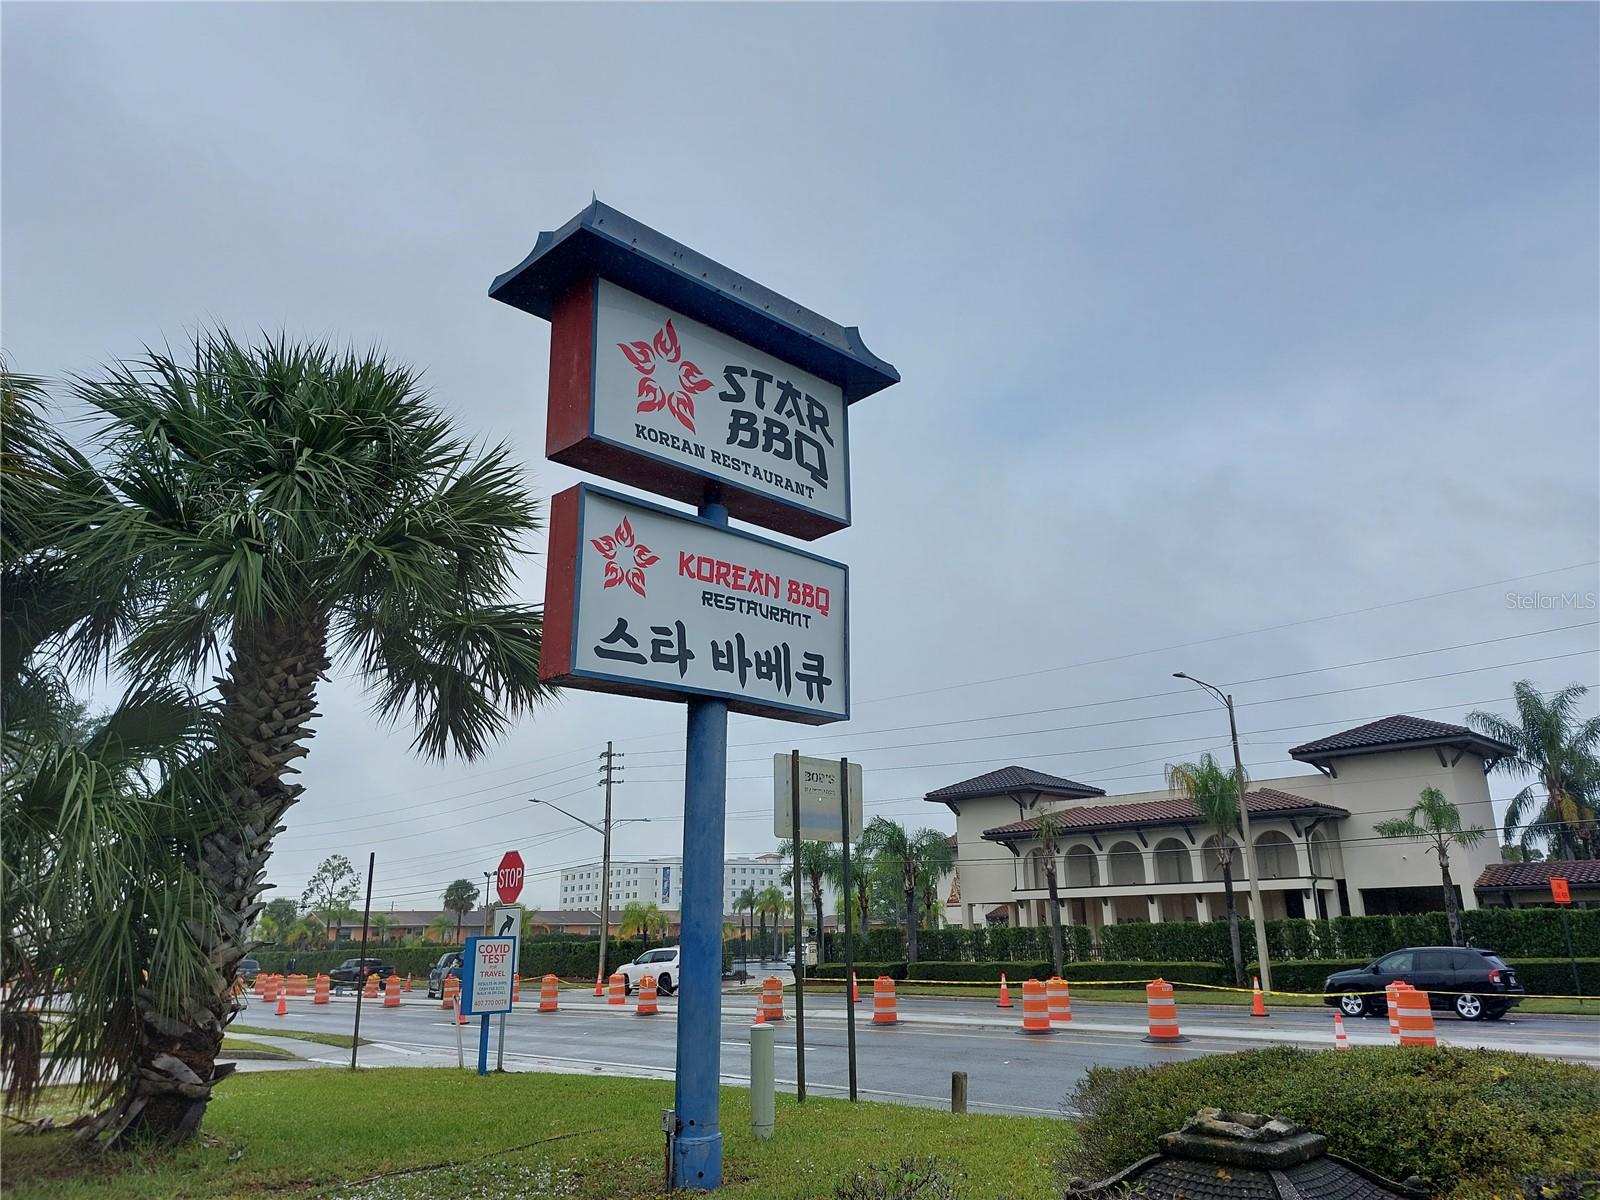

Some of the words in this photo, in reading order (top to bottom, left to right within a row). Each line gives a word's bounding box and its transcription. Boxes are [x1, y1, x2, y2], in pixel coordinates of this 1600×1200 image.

[718, 364, 834, 448] STAR
[634, 423, 706, 459] KOREAN
[710, 448, 815, 499] RESTAURANT
[726, 408, 829, 490] BBQ
[678, 550, 780, 599] KOREAN
[787, 578, 830, 617] BBQ
[701, 590, 812, 629] RESTAURANT
[593, 616, 696, 679] 스타
[710, 632, 833, 704] 바베큐
[498, 867, 523, 889] STOP
[478, 944, 511, 954] COVID
[481, 954, 507, 964] TEST
